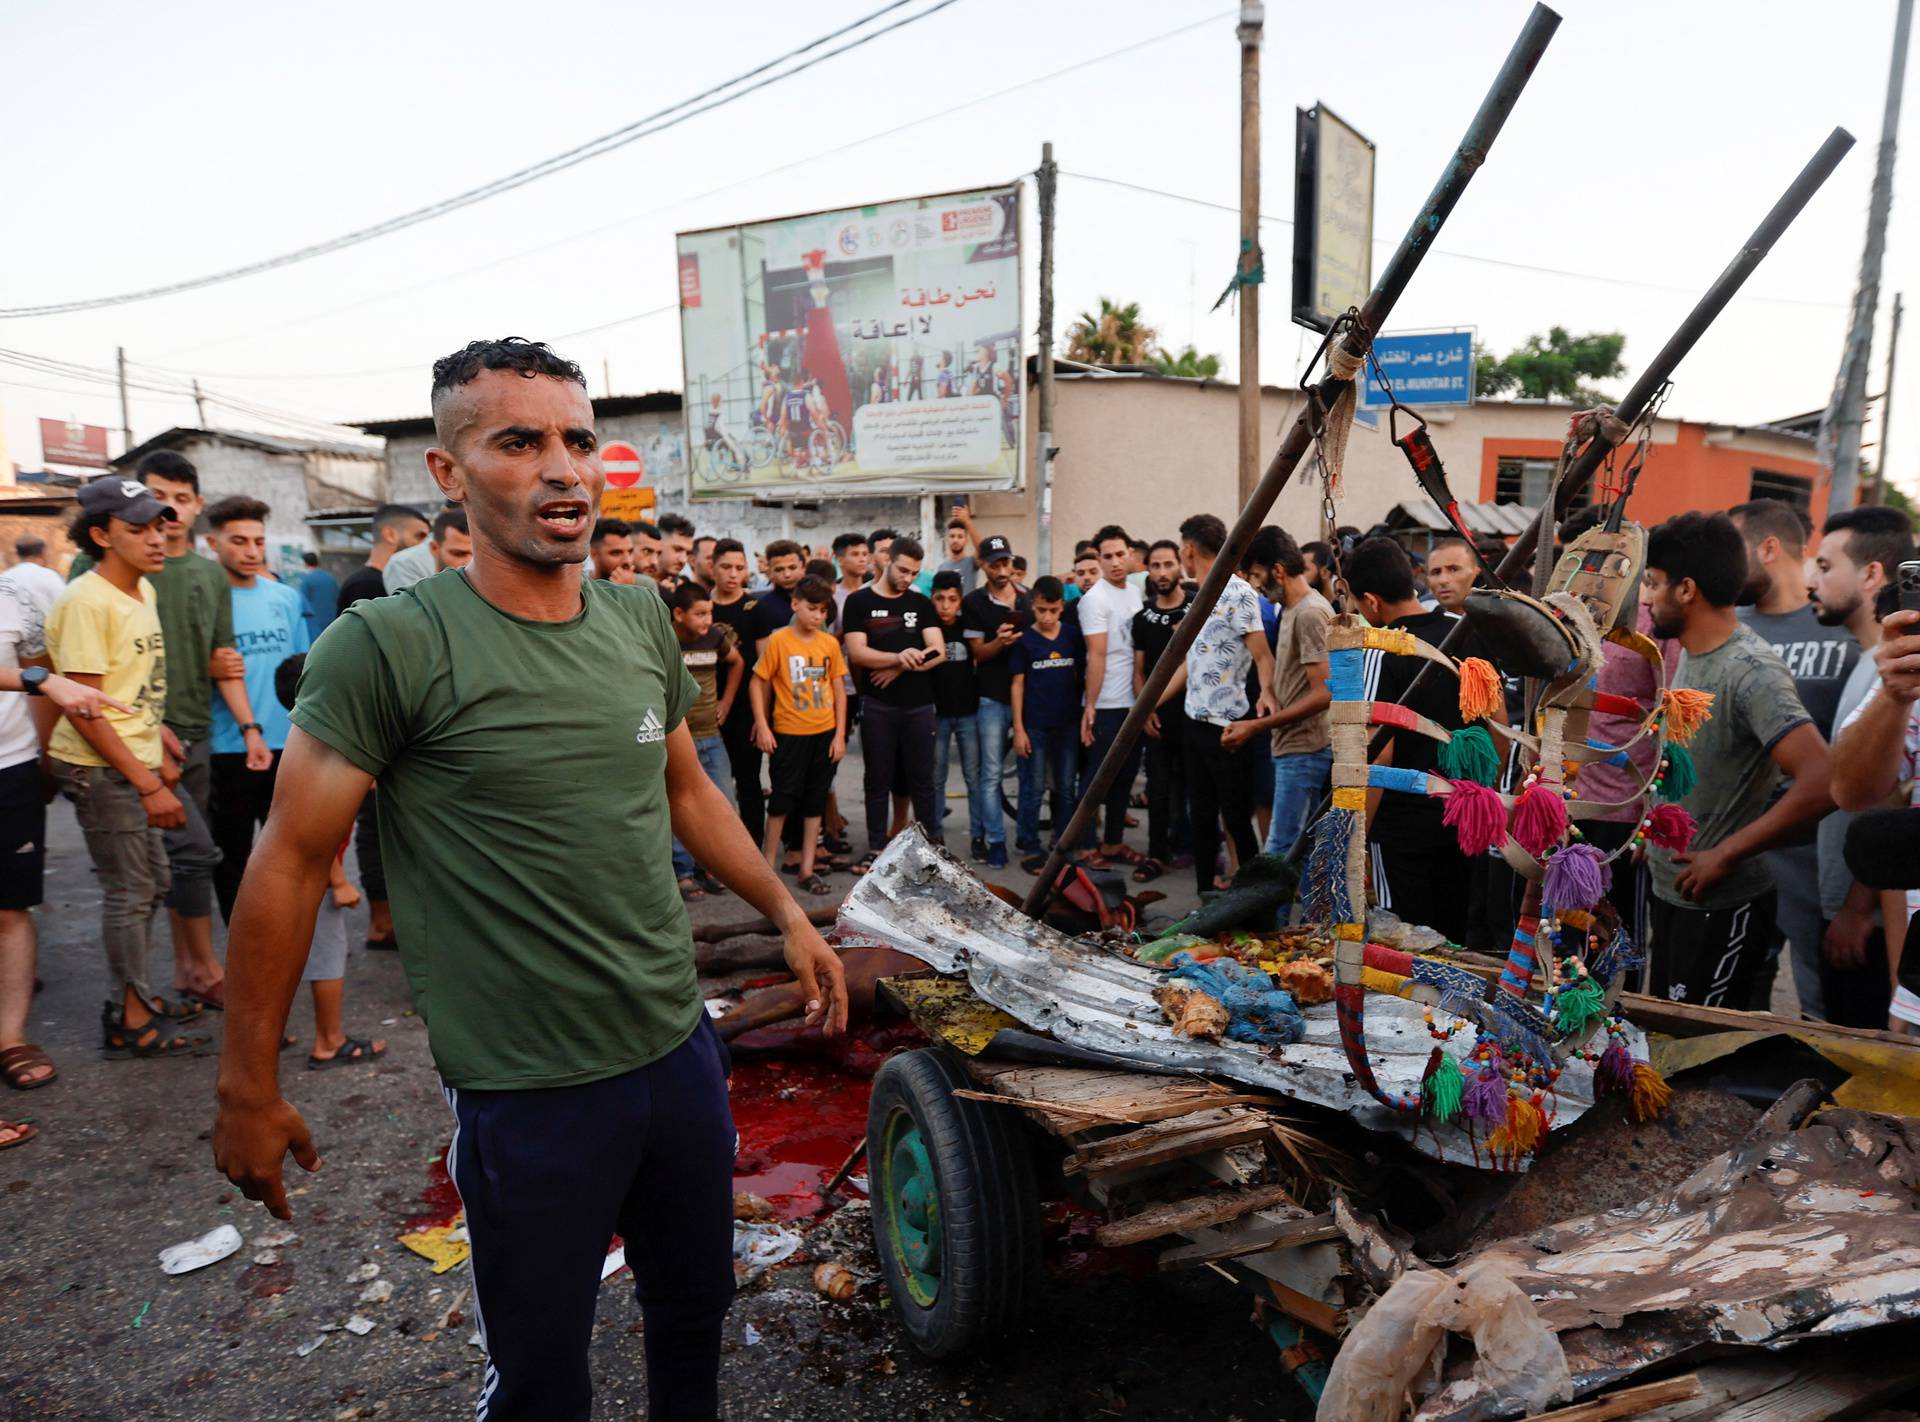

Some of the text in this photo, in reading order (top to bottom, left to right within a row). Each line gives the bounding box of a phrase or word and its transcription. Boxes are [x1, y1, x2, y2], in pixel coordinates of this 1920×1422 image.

[901, 280, 996, 308] نحن طاقة
[918, 314, 933, 334] لا
[1410, 352, 1434, 367] عمر
[1436, 346, 1464, 367] شارع
[1142, 608, 1161, 624] THE
[232, 628, 287, 648] TIHAD
